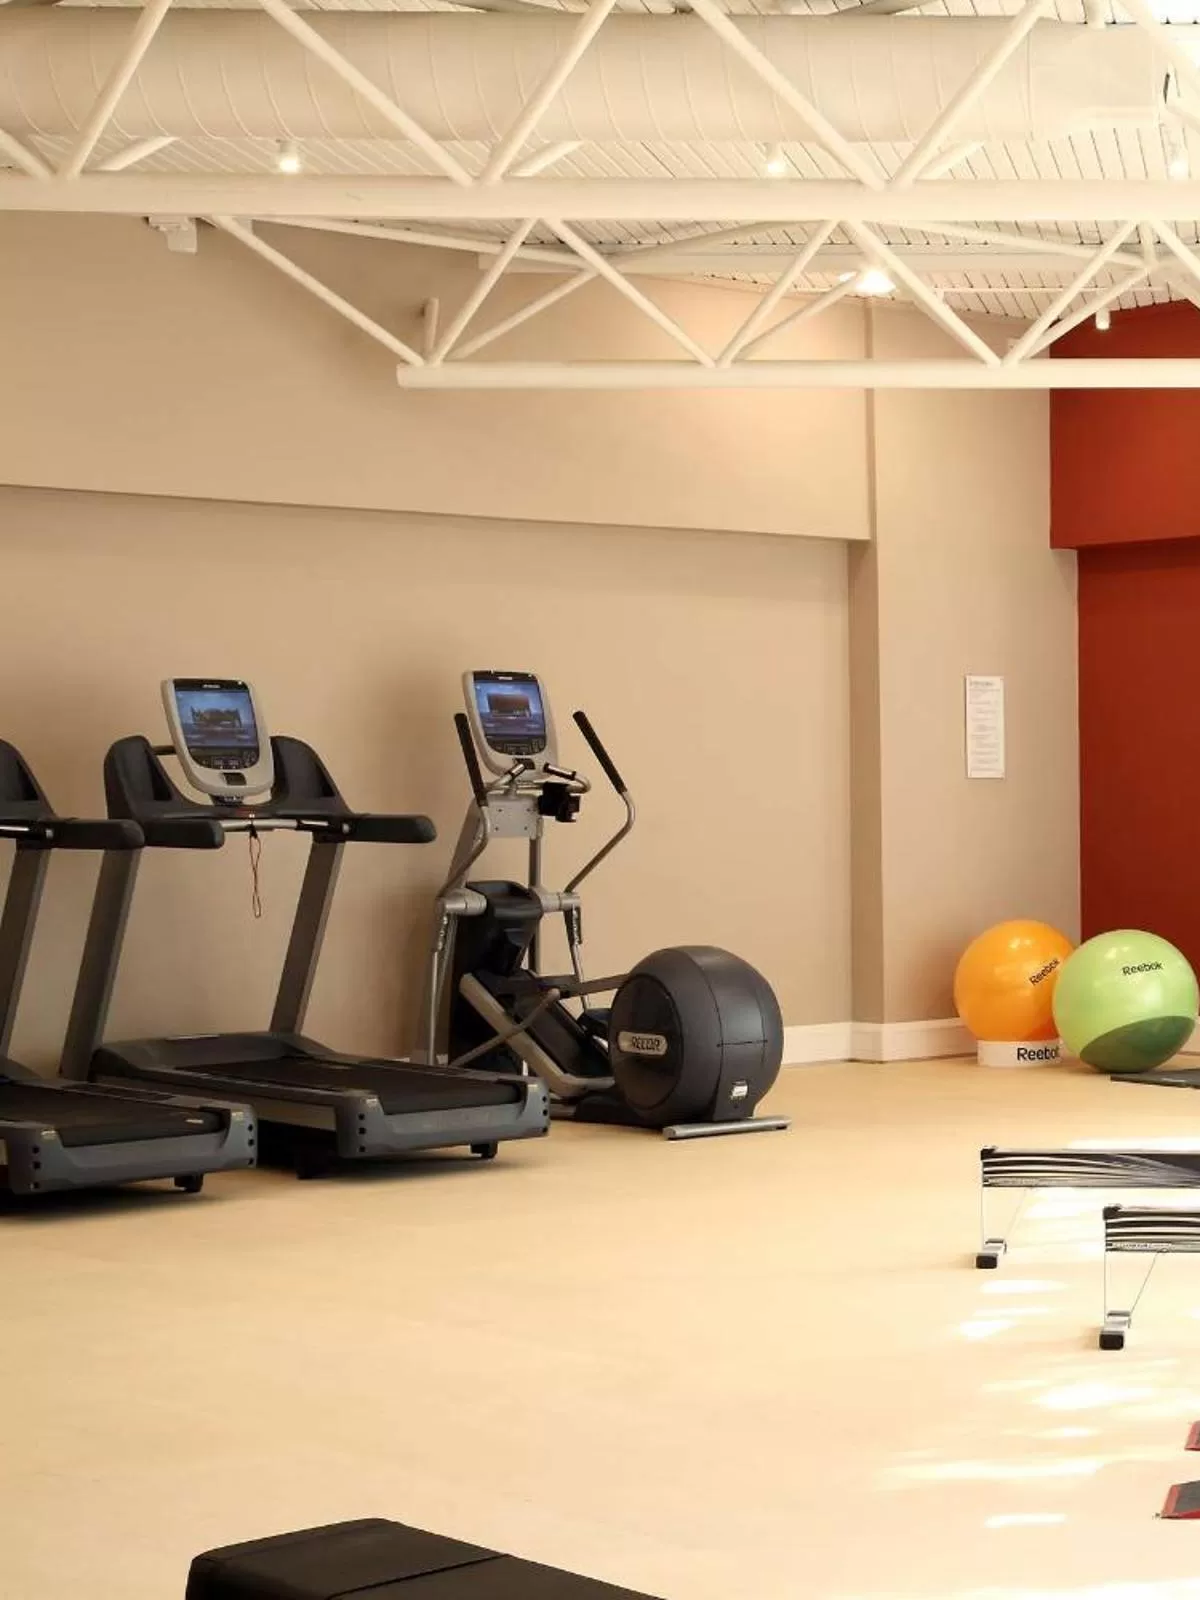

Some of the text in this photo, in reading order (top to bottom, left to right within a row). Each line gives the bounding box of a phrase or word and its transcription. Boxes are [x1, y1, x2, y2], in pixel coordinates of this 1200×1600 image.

[1029, 957, 1061, 986] Reebok
[1122, 961, 1164, 977] Reebok
[1016, 1045, 1060, 1061] Reebo
